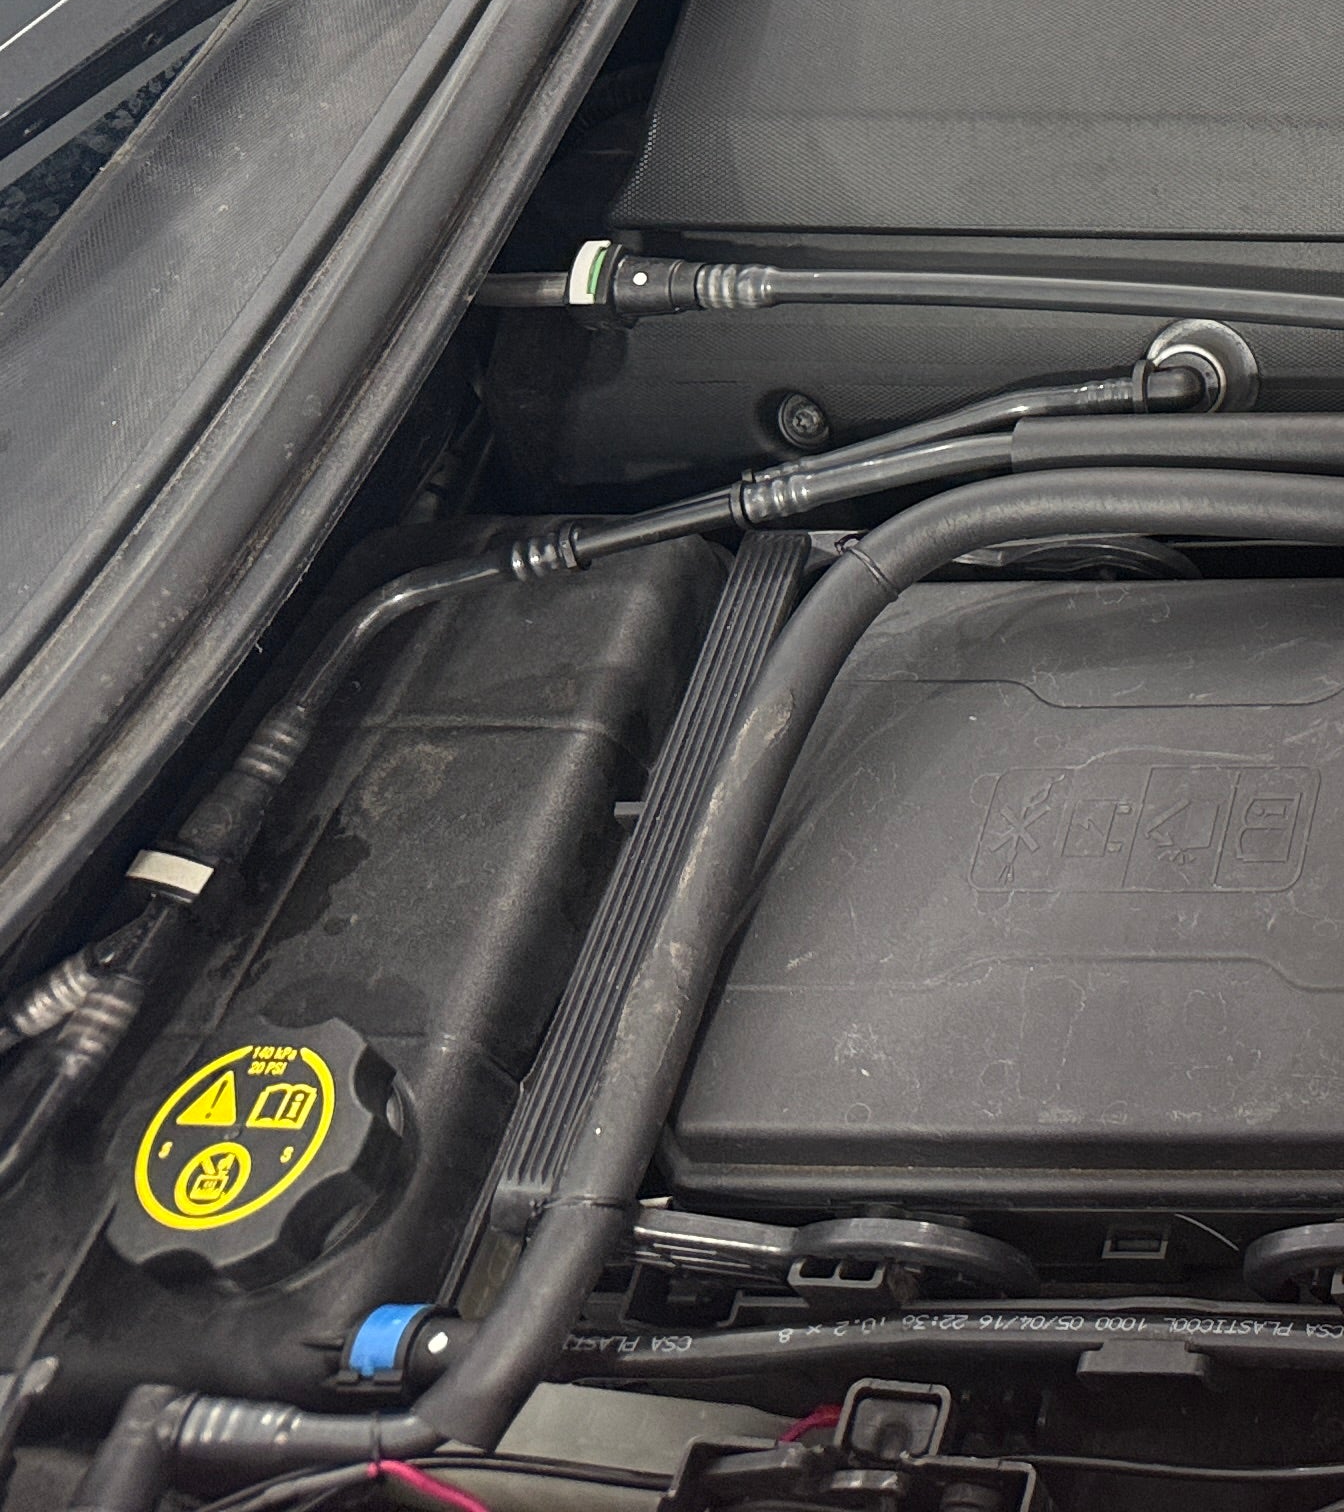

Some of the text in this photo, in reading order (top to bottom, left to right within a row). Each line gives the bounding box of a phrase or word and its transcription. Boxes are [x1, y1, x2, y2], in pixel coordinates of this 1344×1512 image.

[979, 1314, 1085, 1332] 05/04/16
[1094, 1316, 1148, 1332] 1000
[1164, 1317, 1295, 1337] PLASTICOOL
[651, 1335, 692, 1352] CSA
[778, 1328, 794, 1344] 8
